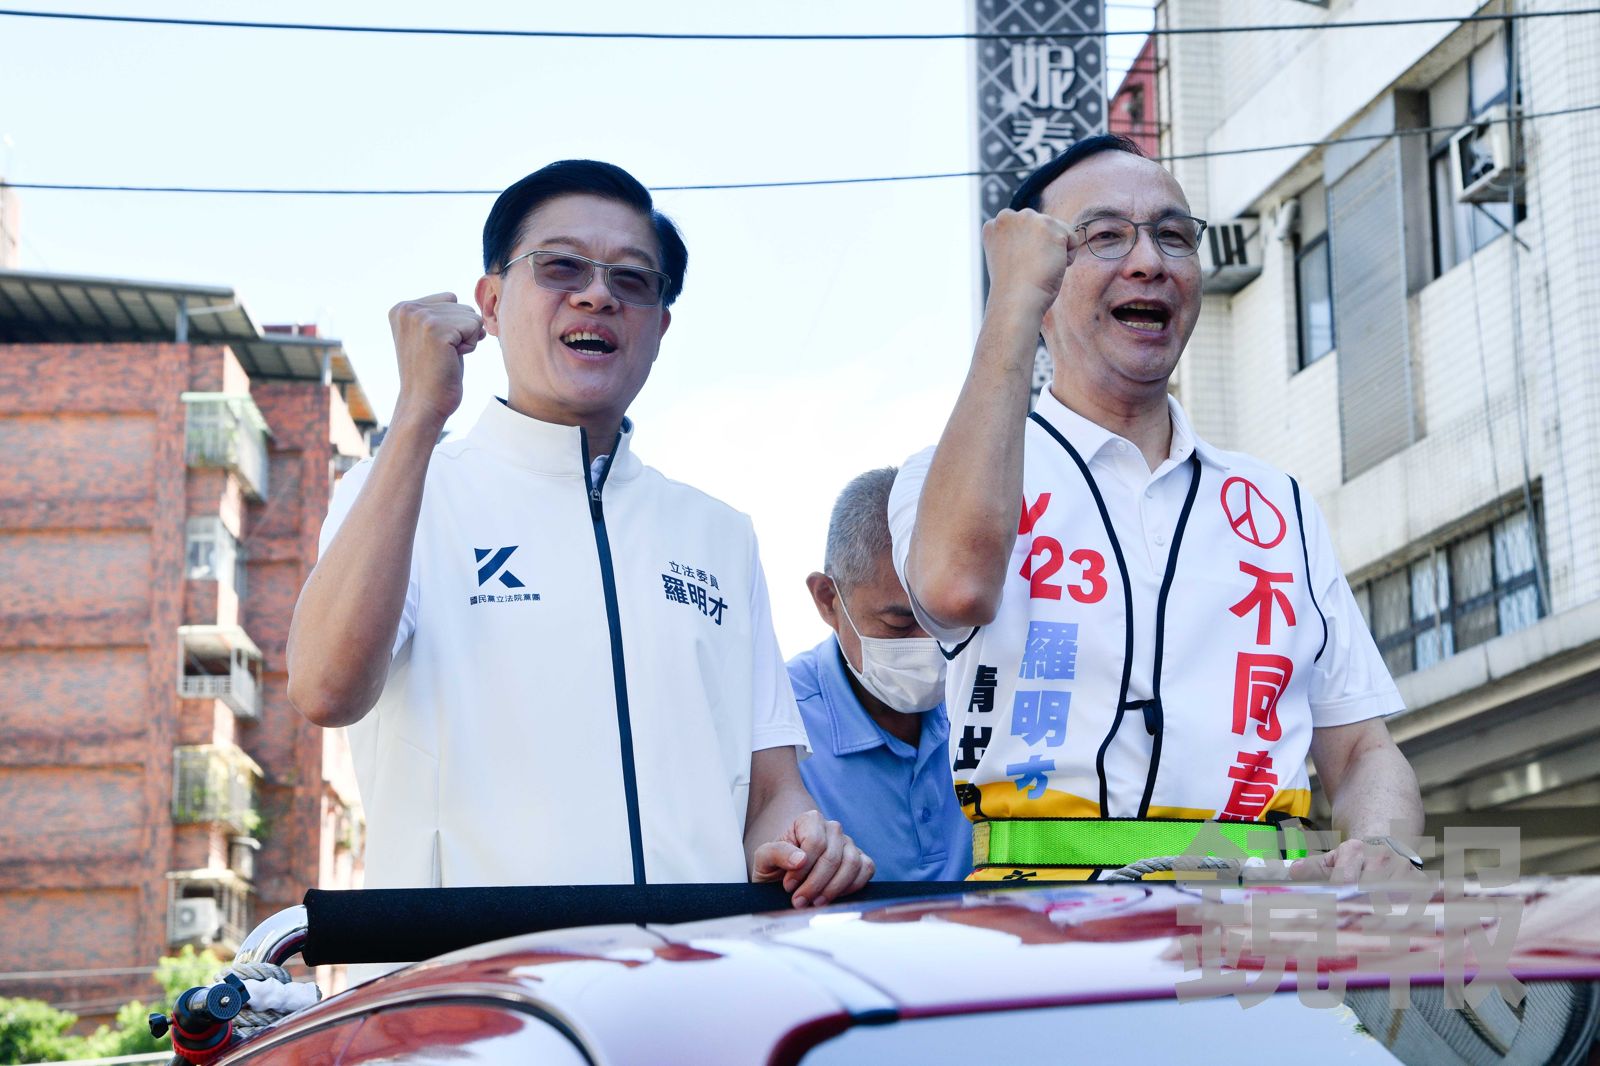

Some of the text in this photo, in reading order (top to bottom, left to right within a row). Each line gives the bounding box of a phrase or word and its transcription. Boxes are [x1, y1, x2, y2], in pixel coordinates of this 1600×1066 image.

[668, 560, 720, 591] 立法委員
[661, 573, 728, 626] 羅明才
